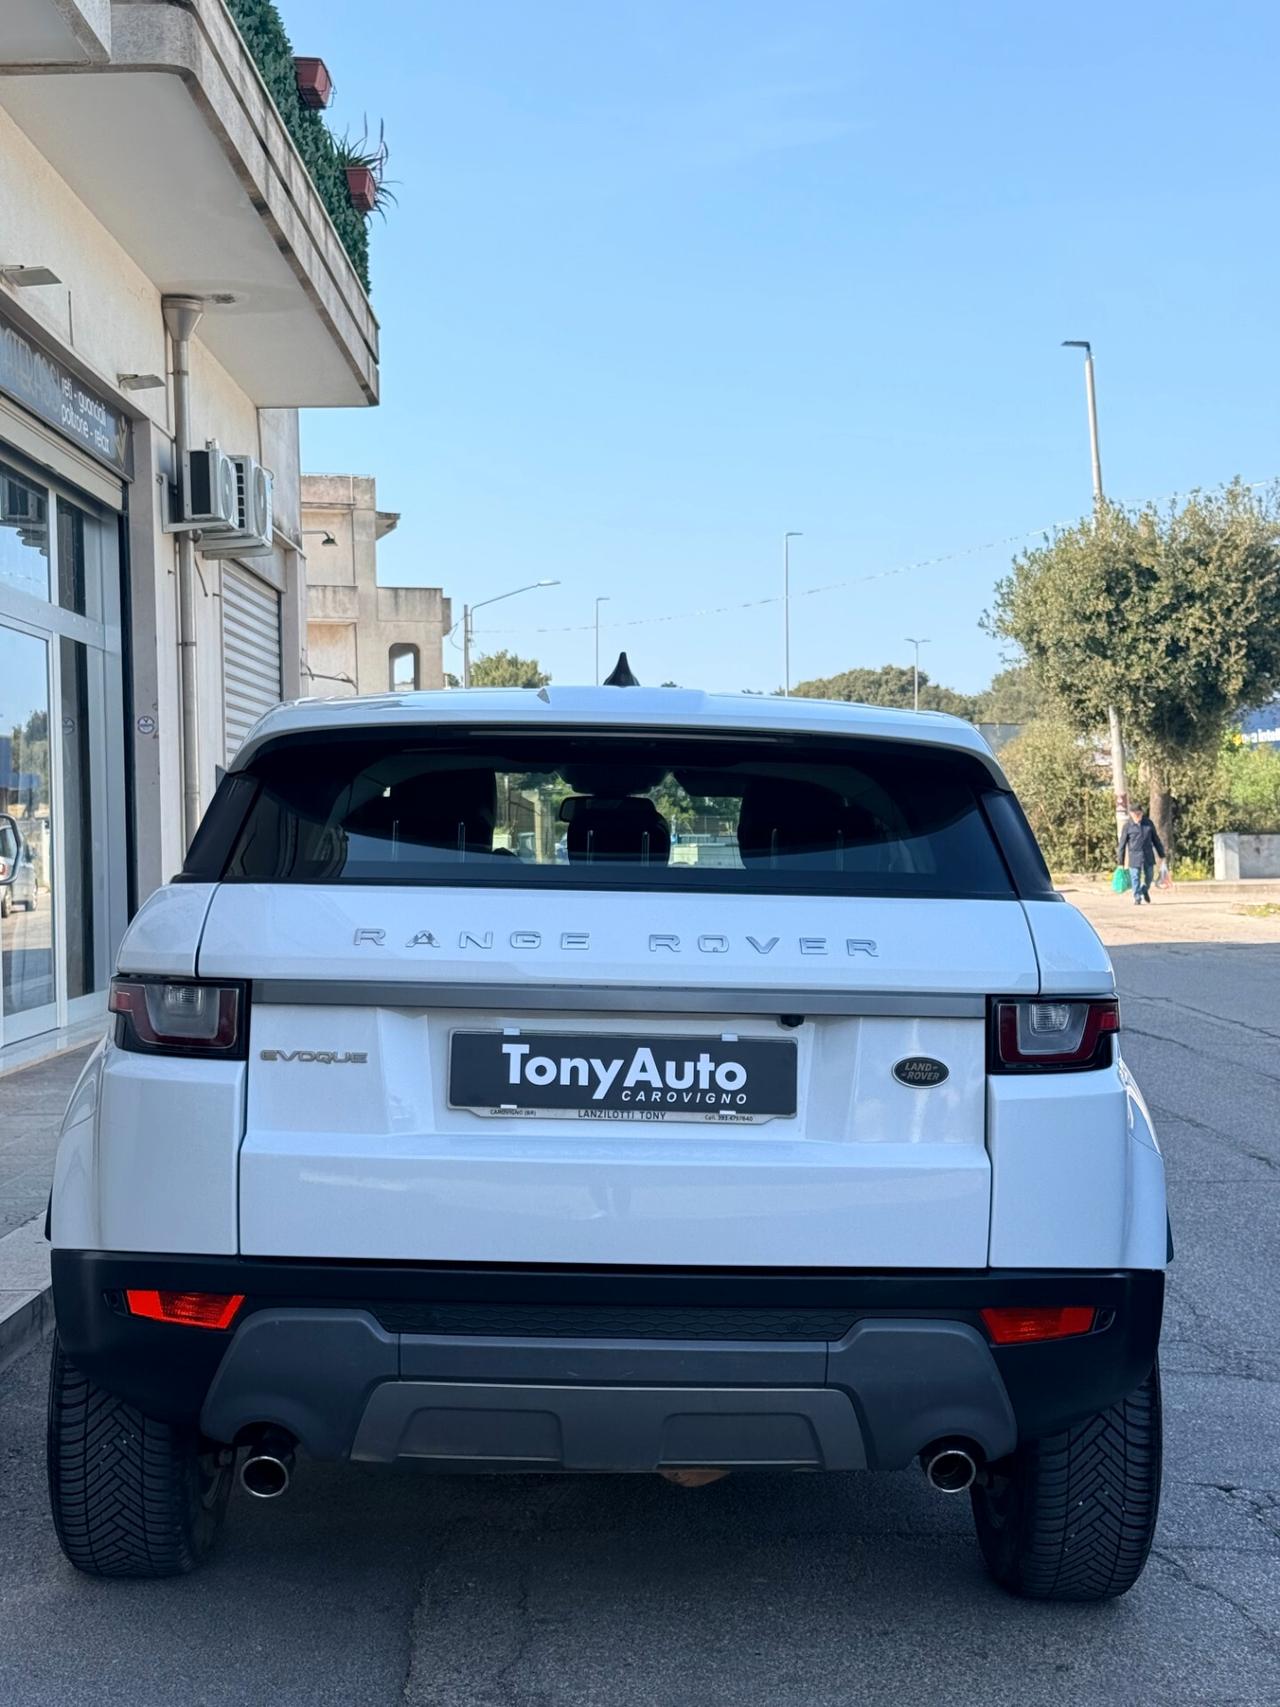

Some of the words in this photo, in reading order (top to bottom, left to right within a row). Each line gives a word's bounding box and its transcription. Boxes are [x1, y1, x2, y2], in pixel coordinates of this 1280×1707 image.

[62, 377, 73, 400] reti
[78, 391, 107, 428] guanciali
[61, 403, 89, 438] poltrone
[94, 426, 111, 454] relax
[353, 928, 590, 951] RANGE
[649, 934, 880, 957] ROVER
[260, 1049, 368, 1064] EVOQUE
[502, 1043, 747, 1100] TonyAuto
[621, 1090, 747, 1105] CAROVIGNO
[578, 1110, 635, 1119] LANZILOTTI
[639, 1111, 667, 1120] TONY
